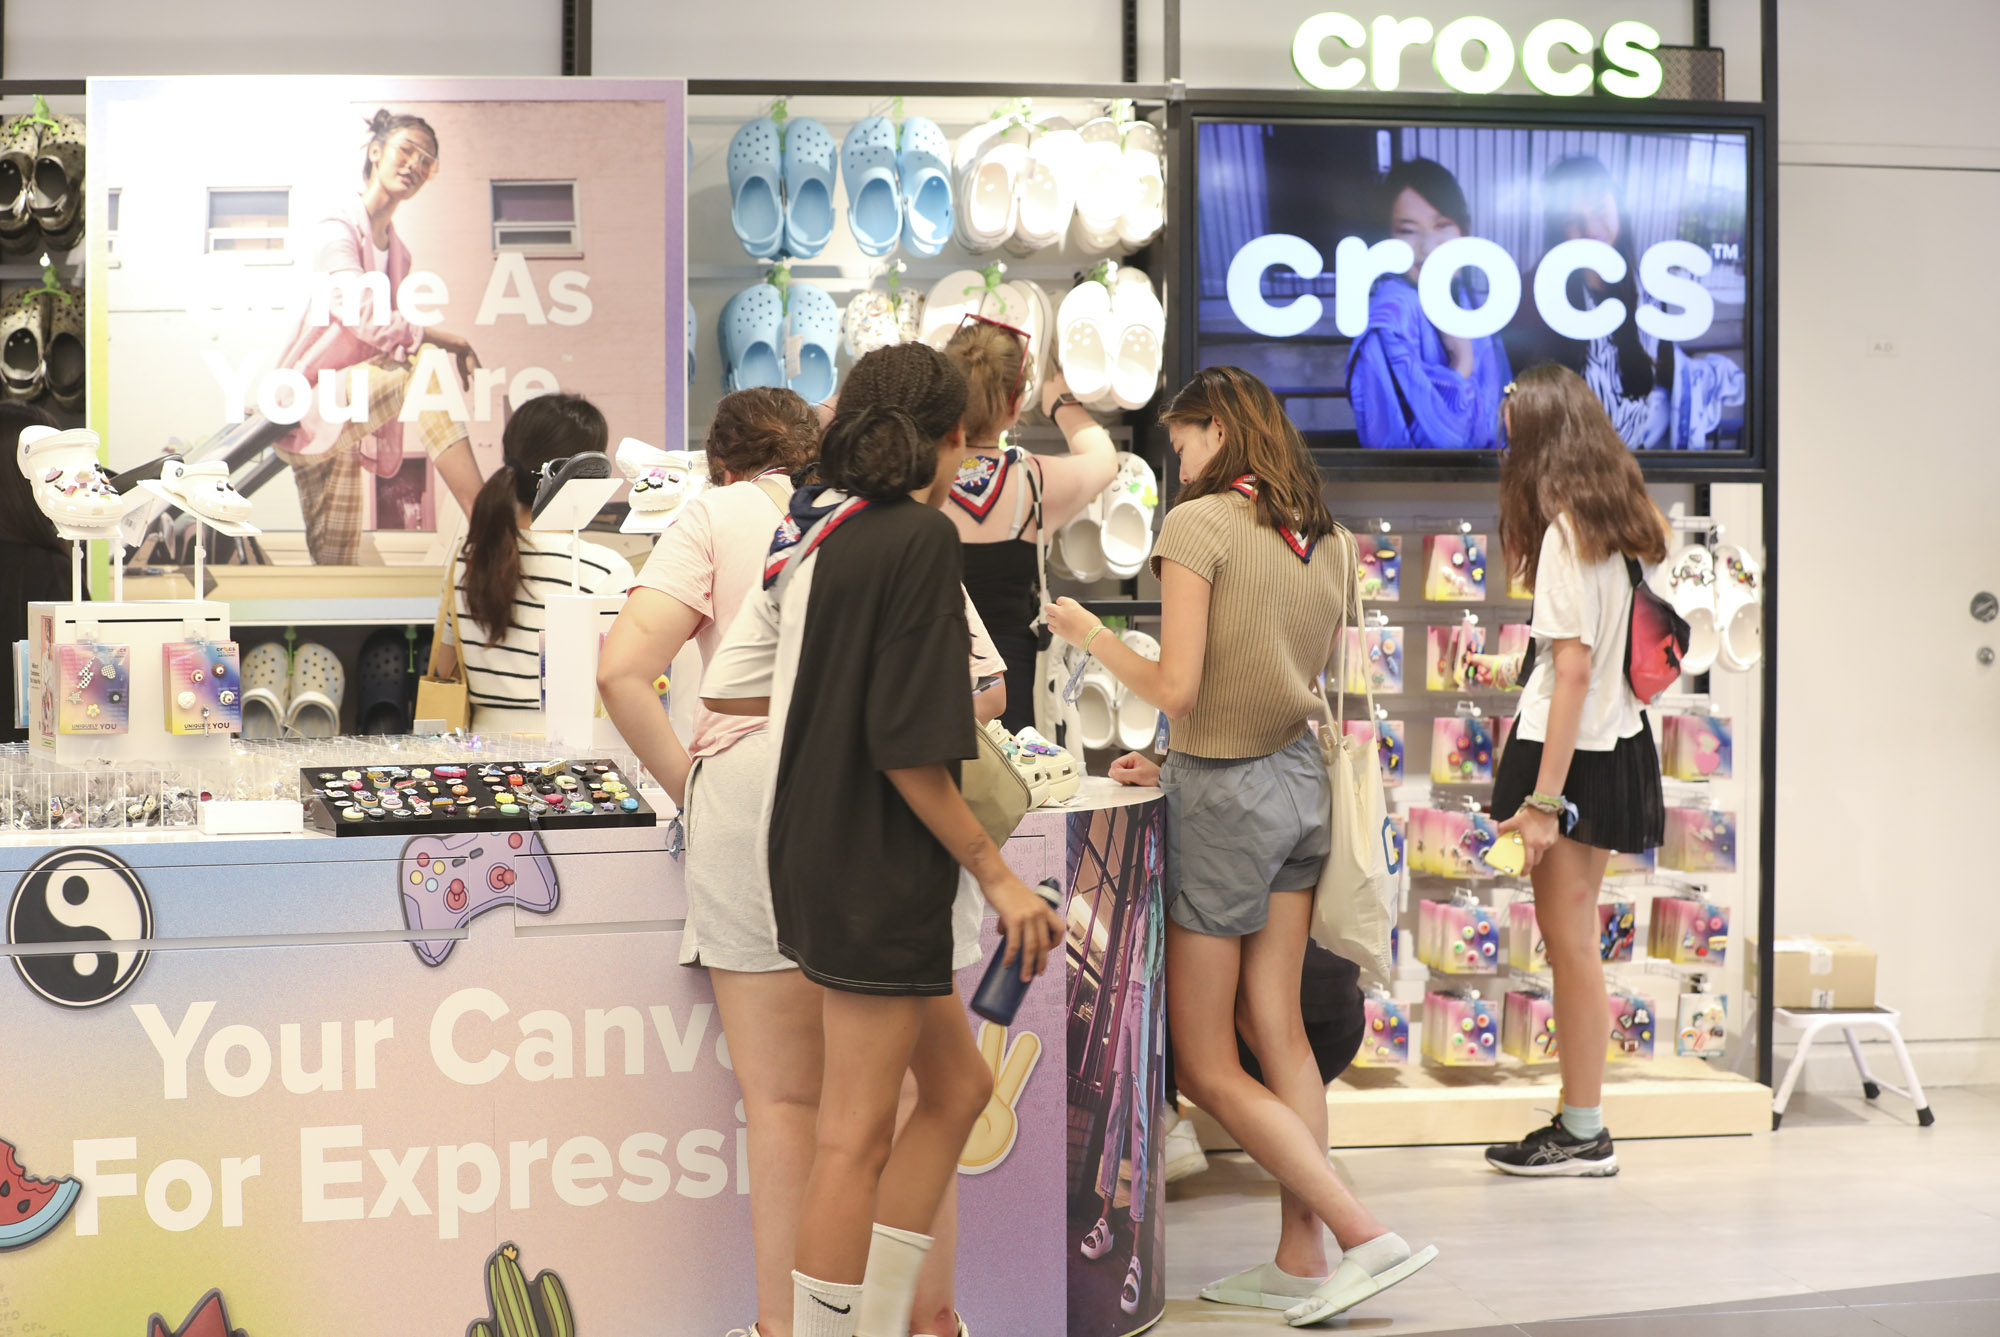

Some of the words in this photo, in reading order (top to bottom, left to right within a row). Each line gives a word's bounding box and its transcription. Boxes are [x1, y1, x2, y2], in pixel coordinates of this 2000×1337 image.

[1291, 11, 1664, 98] crocs
[475, 252, 593, 326] As
[1226, 233, 1715, 342] crocs
[202, 350, 370, 425] You
[397, 348, 561, 423] Are
[130, 1000, 394, 1100] Your
[73, 1136, 261, 1236] For
